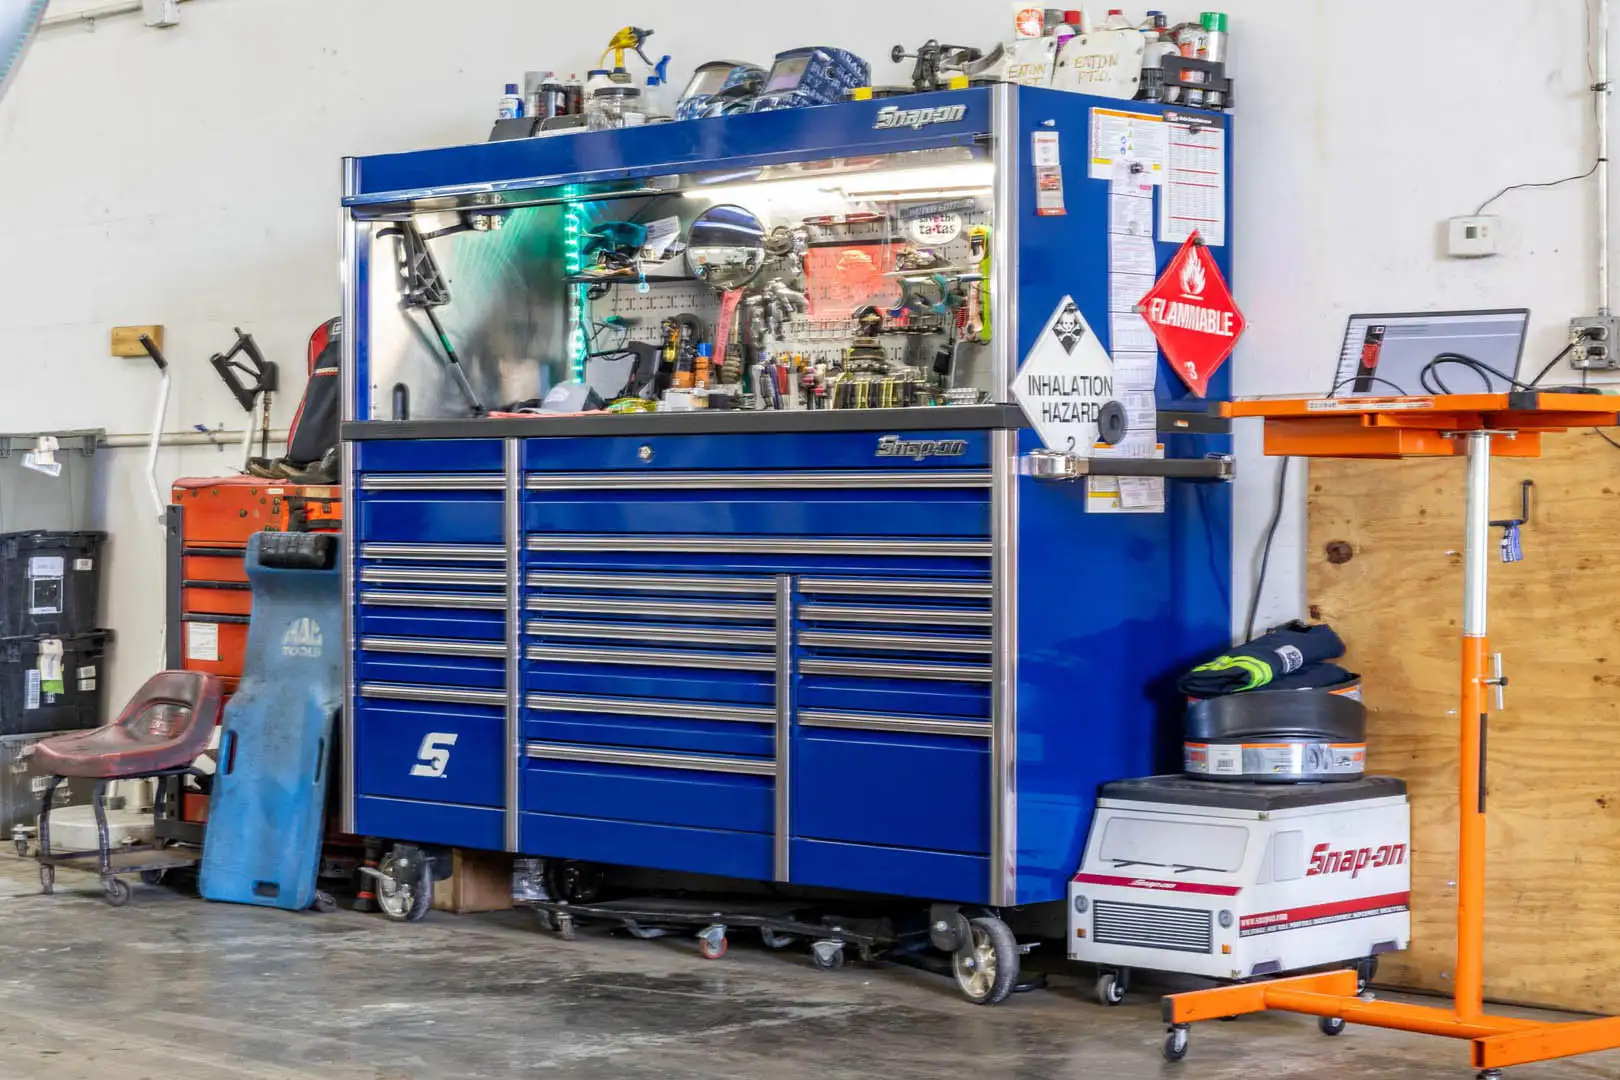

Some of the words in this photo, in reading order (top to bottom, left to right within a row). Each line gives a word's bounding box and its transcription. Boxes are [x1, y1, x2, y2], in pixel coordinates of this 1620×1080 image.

[1074, 53, 1118, 69] EATON
[1150, 298, 1234, 337] FLAMMABLE
[1184, 360, 1198, 380] 3
[1028, 374, 1113, 396] INHALATION
[1042, 402, 1100, 423] HAZARD
[1067, 435, 1076, 452] 2
[282, 617, 323, 646] MAC
[282, 646, 323, 658] TOOLS
[1306, 842, 1408, 879] Snap-on
